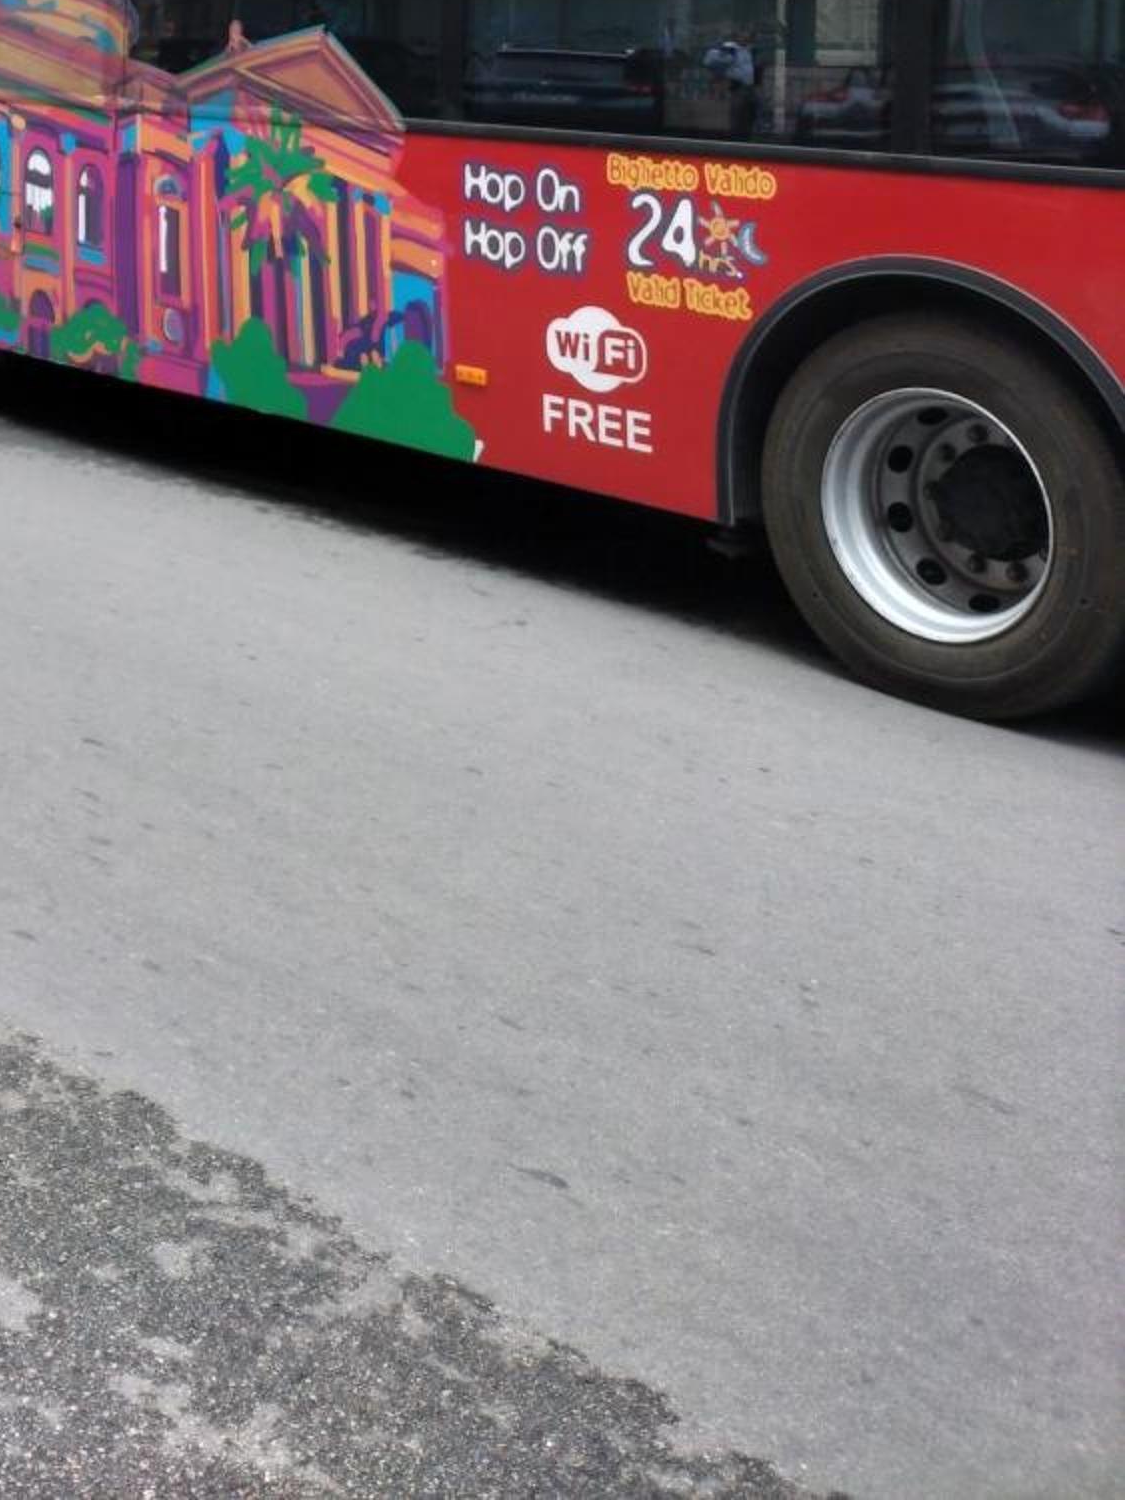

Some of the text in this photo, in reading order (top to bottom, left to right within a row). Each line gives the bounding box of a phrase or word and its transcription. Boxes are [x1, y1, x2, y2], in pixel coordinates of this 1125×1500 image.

[464, 163, 580, 213] Hop On
[607, 153, 777, 200] Biglietto Valido
[464, 218, 588, 273] Hop Off
[627, 193, 696, 267] 24
[626, 271, 753, 321] Valid Ticket
[541, 393, 654, 453] FREE
